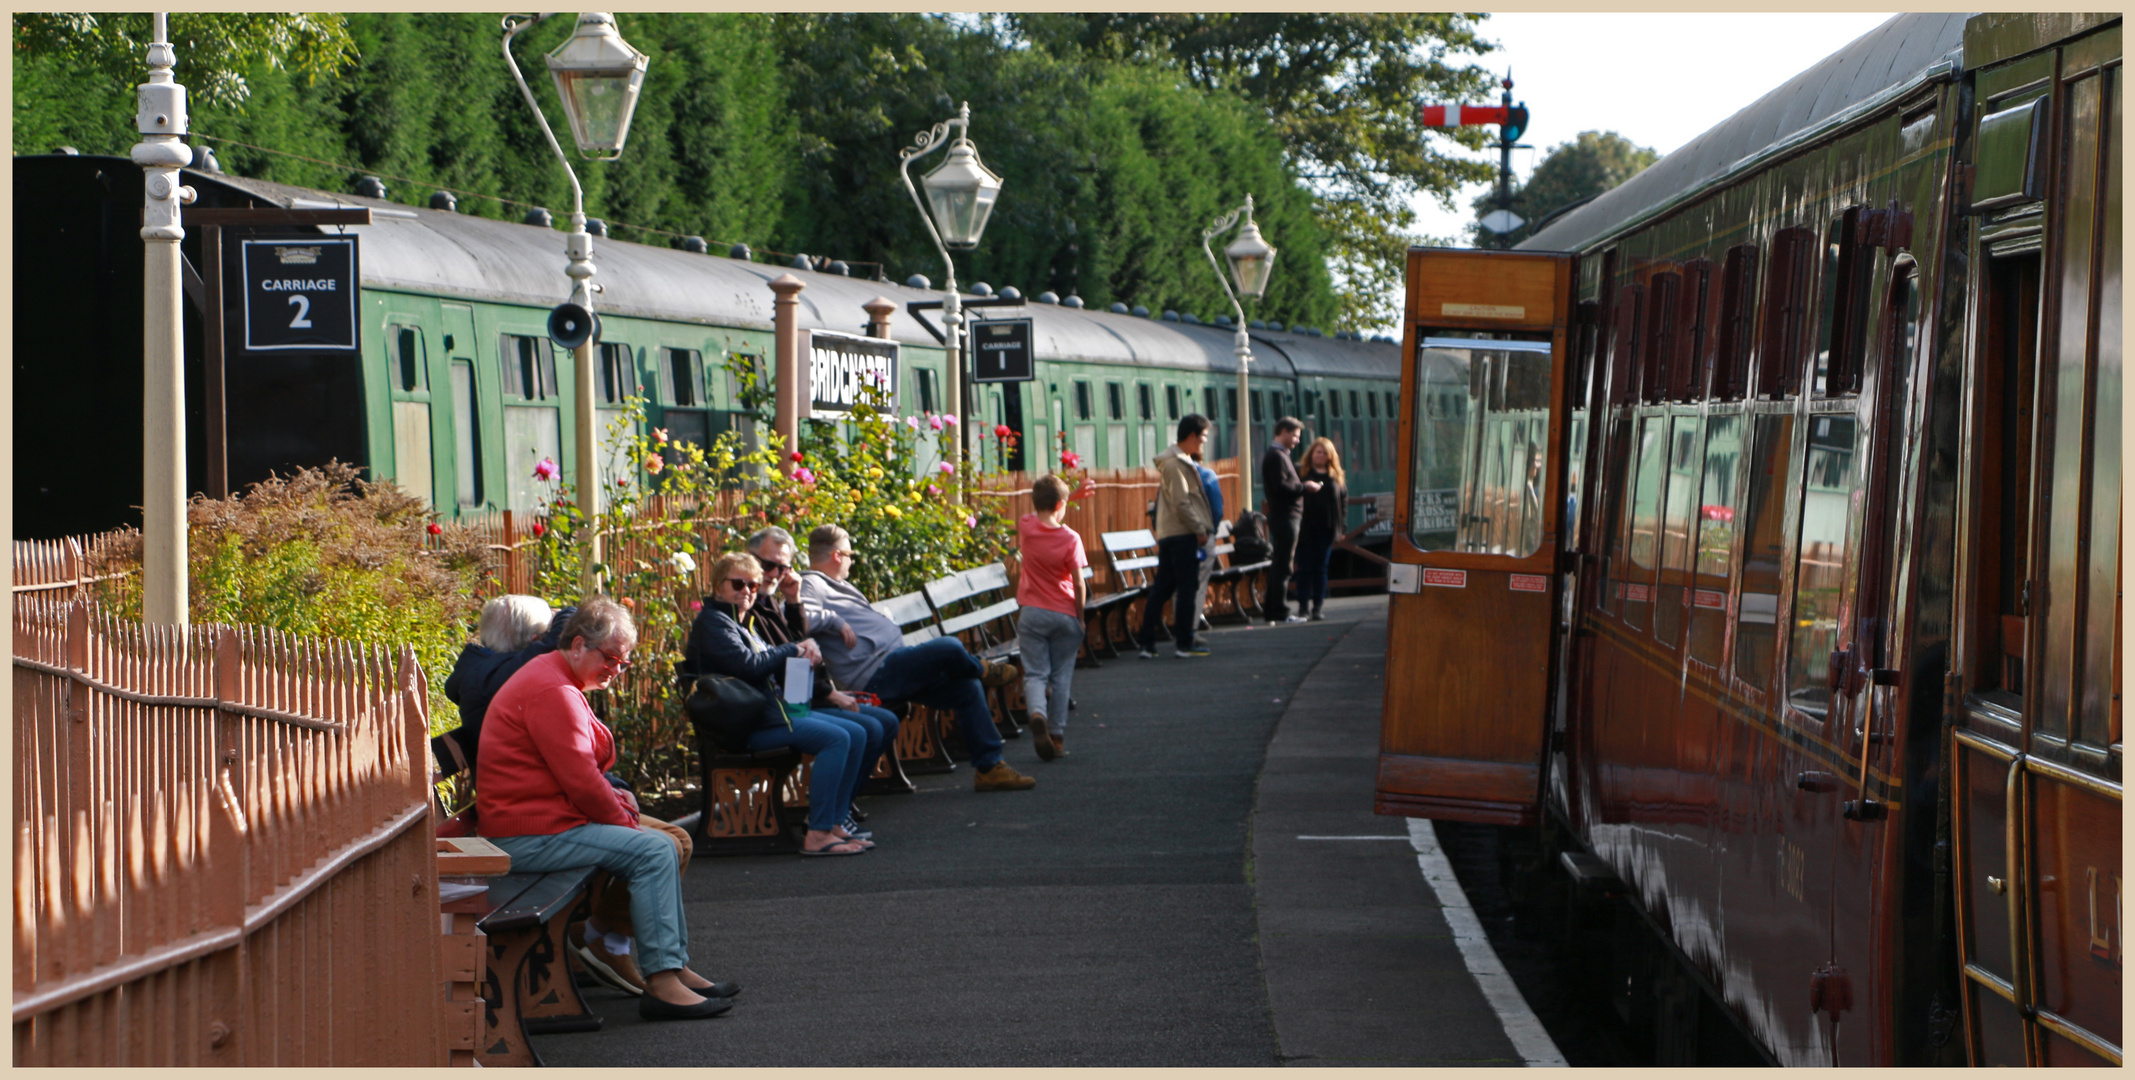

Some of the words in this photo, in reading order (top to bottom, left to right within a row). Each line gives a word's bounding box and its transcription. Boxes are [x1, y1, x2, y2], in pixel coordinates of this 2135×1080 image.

[262, 279, 336, 291] CARRIAGE
[288, 294, 313, 329] 2
[982, 341, 1021, 350] CARRIAGE
[810, 347, 892, 408] BRIDGNORTH
